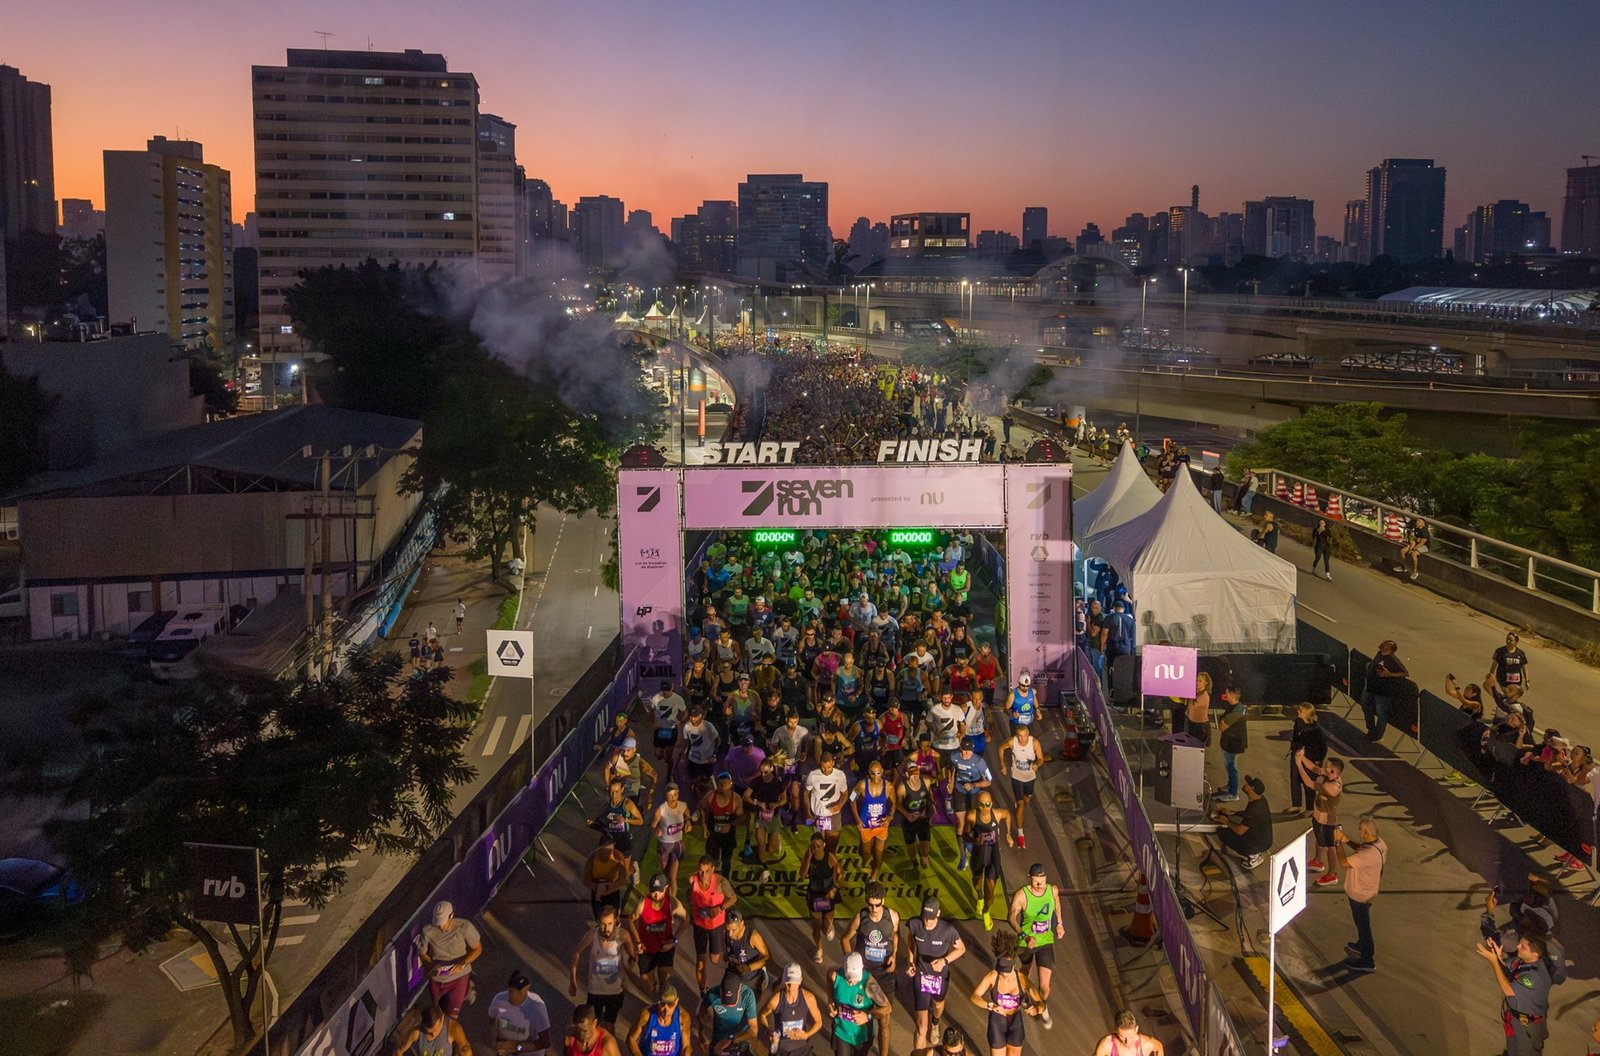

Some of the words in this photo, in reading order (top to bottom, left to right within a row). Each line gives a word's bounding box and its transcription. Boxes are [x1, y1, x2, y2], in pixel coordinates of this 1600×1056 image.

[703, 442, 800, 464] START
[877, 439, 982, 462] FINISH
[776, 479, 854, 498] seven
[871, 495, 902, 503] presented
[903, 495, 911, 503] by
[920, 492, 944, 505] nu
[777, 496, 822, 516] run
[1154, 664, 1184, 680] nu
[550, 757, 567, 802] nu
[488, 824, 511, 880] nu
[203, 876, 245, 898] rvb
